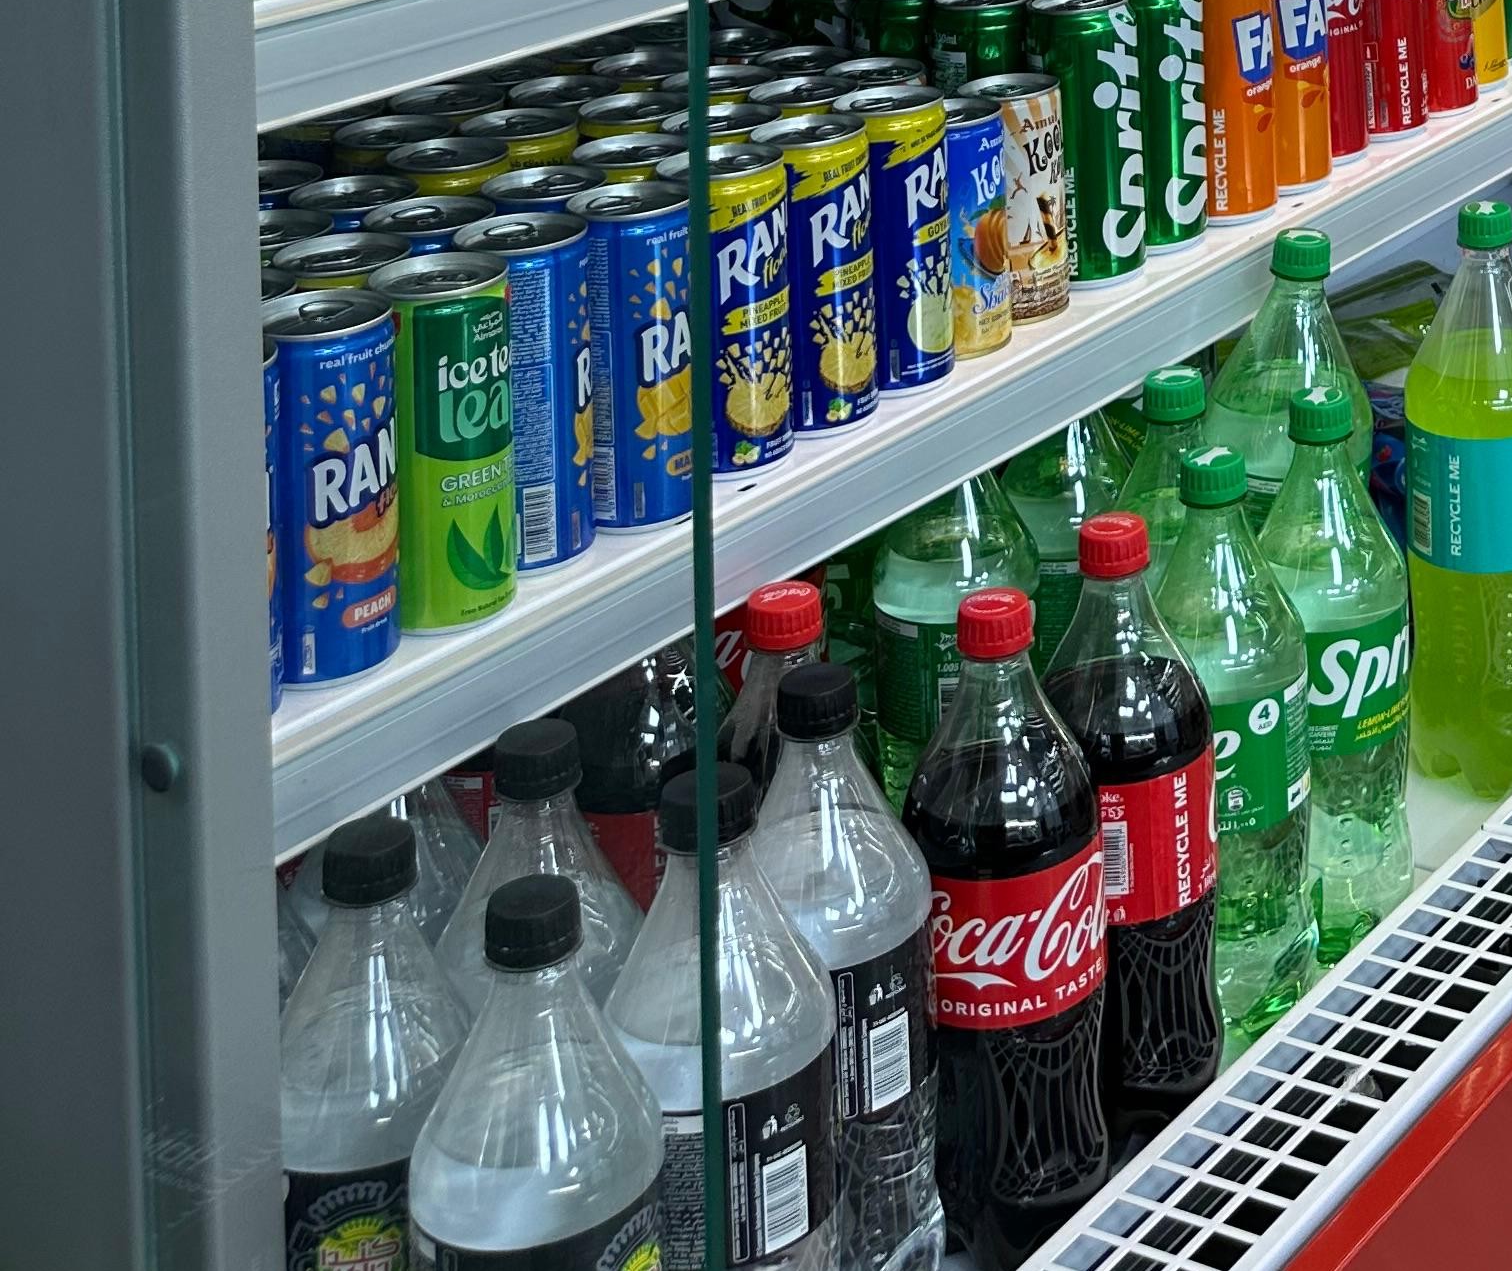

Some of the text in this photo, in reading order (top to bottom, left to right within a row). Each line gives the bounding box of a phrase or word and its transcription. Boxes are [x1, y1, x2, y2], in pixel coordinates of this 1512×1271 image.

[1289, 55, 1322, 75] orange
[1397, 36, 1413, 126] RECYCLE ME
[1212, 108, 1227, 212] RECYCLE ME
[809, 166, 871, 268] RAN
[1064, 167, 1079, 277] RECYCLE ME
[716, 201, 788, 304] RAN
[739, 310, 767, 331] MIXED
[742, 294, 785, 319] PINEAPPLE
[319, 347, 373, 371] real fruit
[438, 352, 488, 393] ice
[312, 418, 397, 523] RAN
[440, 462, 501, 494] GREEN
[1448, 454, 1462, 557] RECYCLE ME
[353, 593, 392, 622] PEACH
[1257, 704, 1271, 721] 4
[1173, 771, 1191, 909] RECYCLE ME
[941, 956, 1104, 1017] ORIGINAL TASTE
